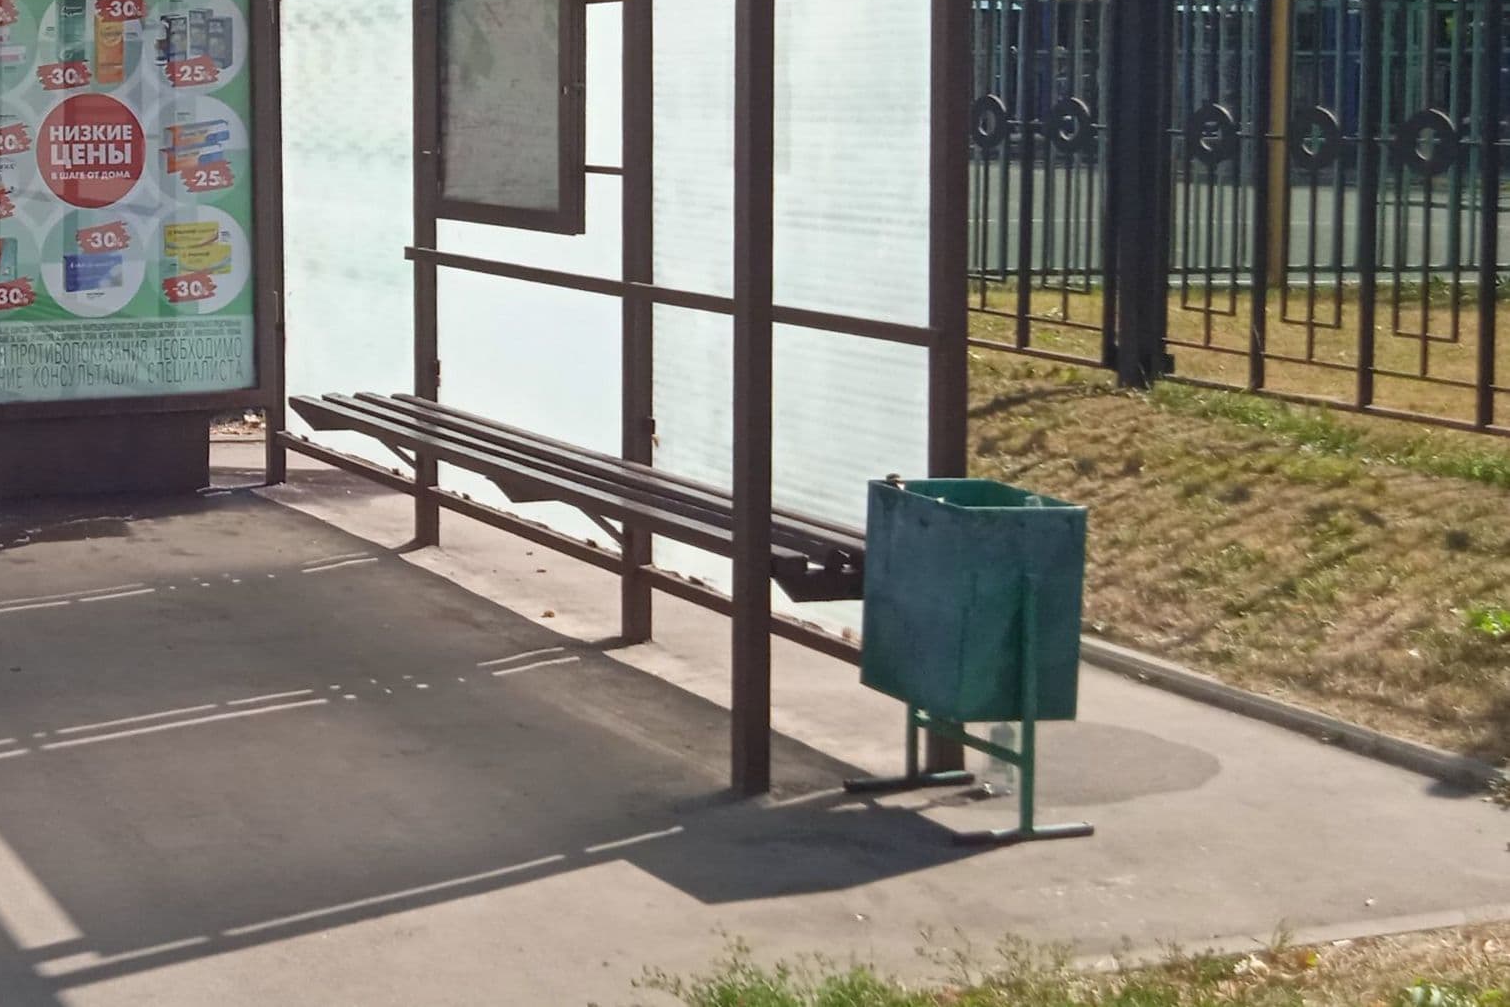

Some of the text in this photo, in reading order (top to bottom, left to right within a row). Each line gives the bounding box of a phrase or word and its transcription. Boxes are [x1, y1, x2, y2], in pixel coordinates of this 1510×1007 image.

[49, 124, 132, 142] НИЗКИЕ
[50, 143, 132, 168] ЦЕНЫ
[59, 172, 85, 181] ШАГЕ
[87, 171, 100, 180] ОТ
[101, 170, 130, 179] ДОМА
[153, 336, 243, 361] НЕОБХОДИМО
[33, 362, 139, 388] КОНСУЛЬТАЦИИ
[147, 358, 245, 384] СПЕЦИАЛИСТА
